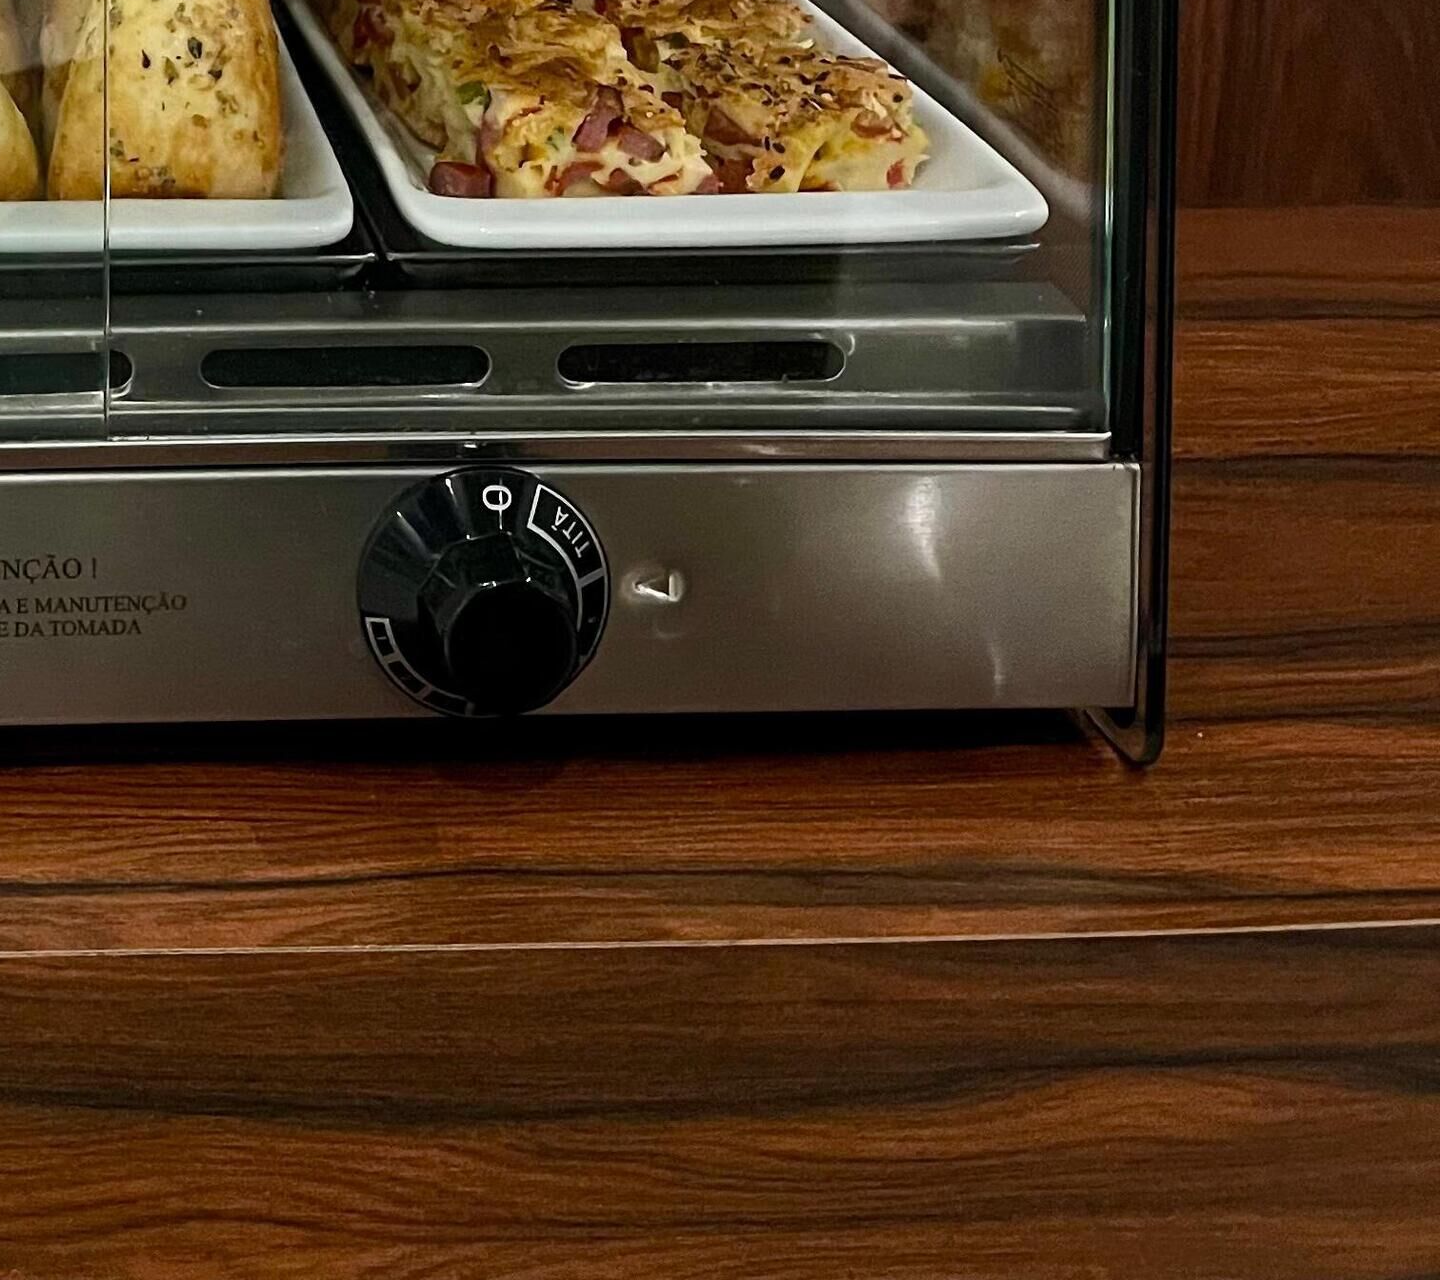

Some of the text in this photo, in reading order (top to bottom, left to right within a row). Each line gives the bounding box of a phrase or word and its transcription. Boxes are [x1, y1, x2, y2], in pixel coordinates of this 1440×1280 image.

[16, 598, 29, 615] E
[35, 592, 188, 616] MANUTENÇÃO
[14, 621, 45, 638] DA
[48, 618, 143, 637] TOMADA
